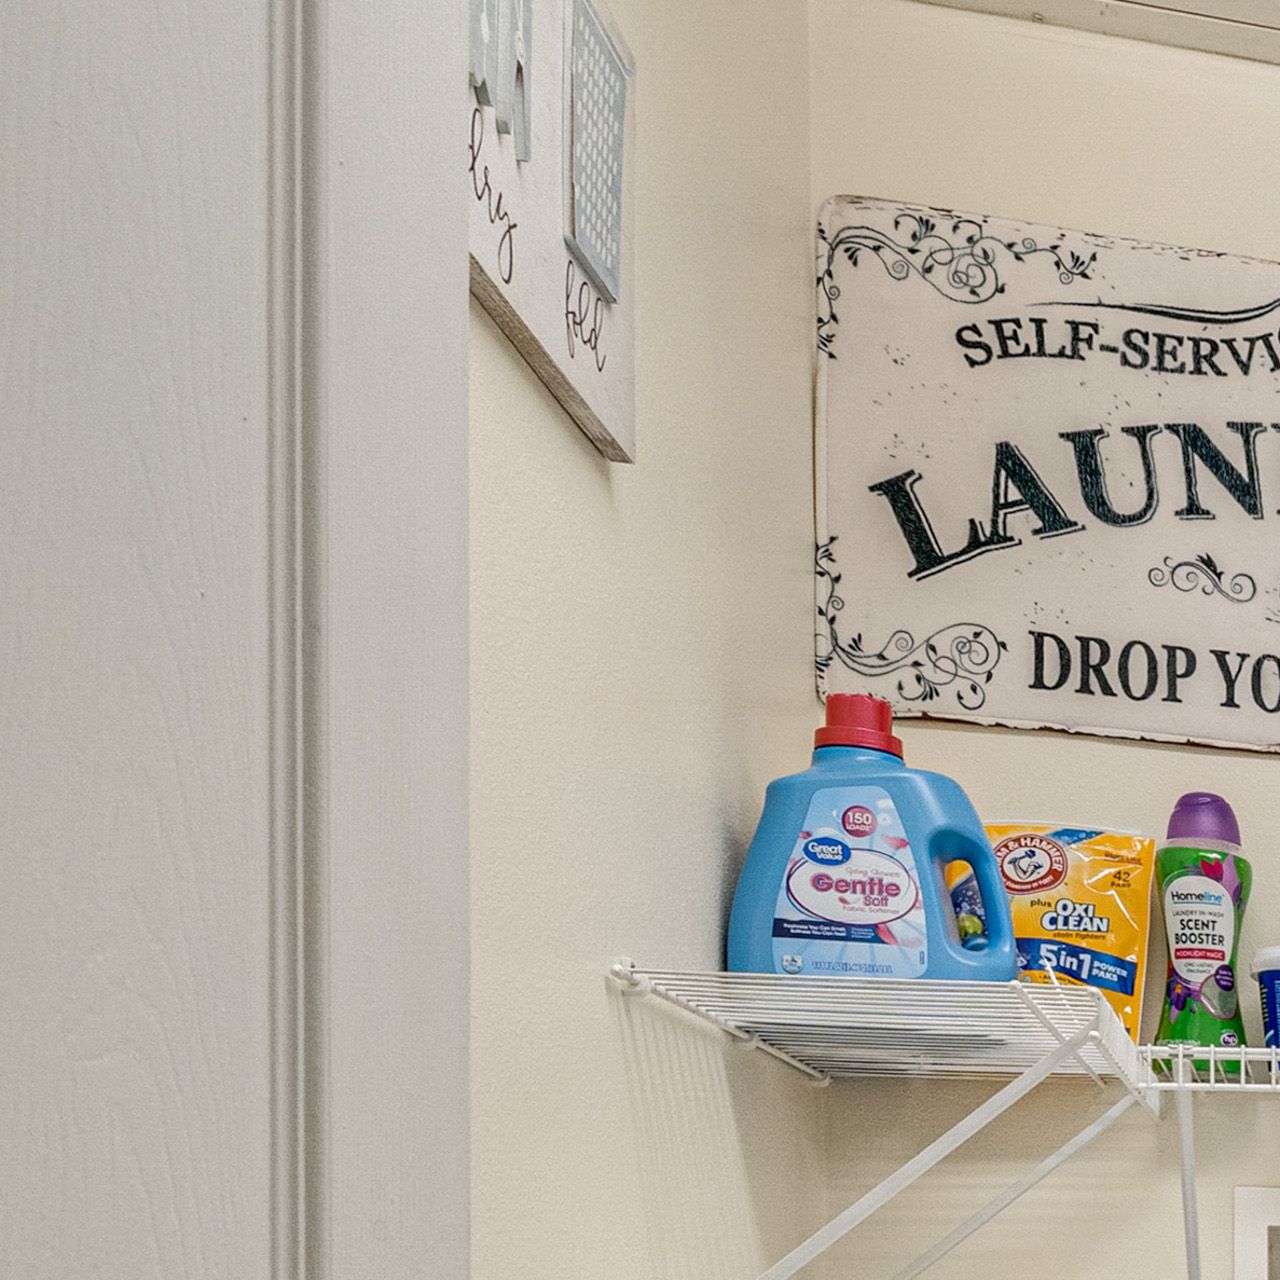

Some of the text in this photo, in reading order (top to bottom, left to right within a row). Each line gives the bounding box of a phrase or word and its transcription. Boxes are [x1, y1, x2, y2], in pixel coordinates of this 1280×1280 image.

[1028, 630, 1197, 703] DROP
[847, 812, 873, 824] 150
[808, 841, 843, 855] Great
[1020, 837, 1063, 871] HAMMER
[816, 851, 843, 861] Value
[1112, 870, 1131, 882] 42
[811, 873, 901, 897] Gentle
[1030, 899, 1052, 907] plus
[1171, 891, 1223, 902] Homeline
[1055, 898, 1095, 917] OXI
[1041, 911, 1109, 932] CLEAN
[1180, 919, 1217, 931] SCENT
[1175, 933, 1225, 946] BOOSTER
[1092, 961, 1128, 977] POWER
[1092, 969, 1118, 981] PAKS
